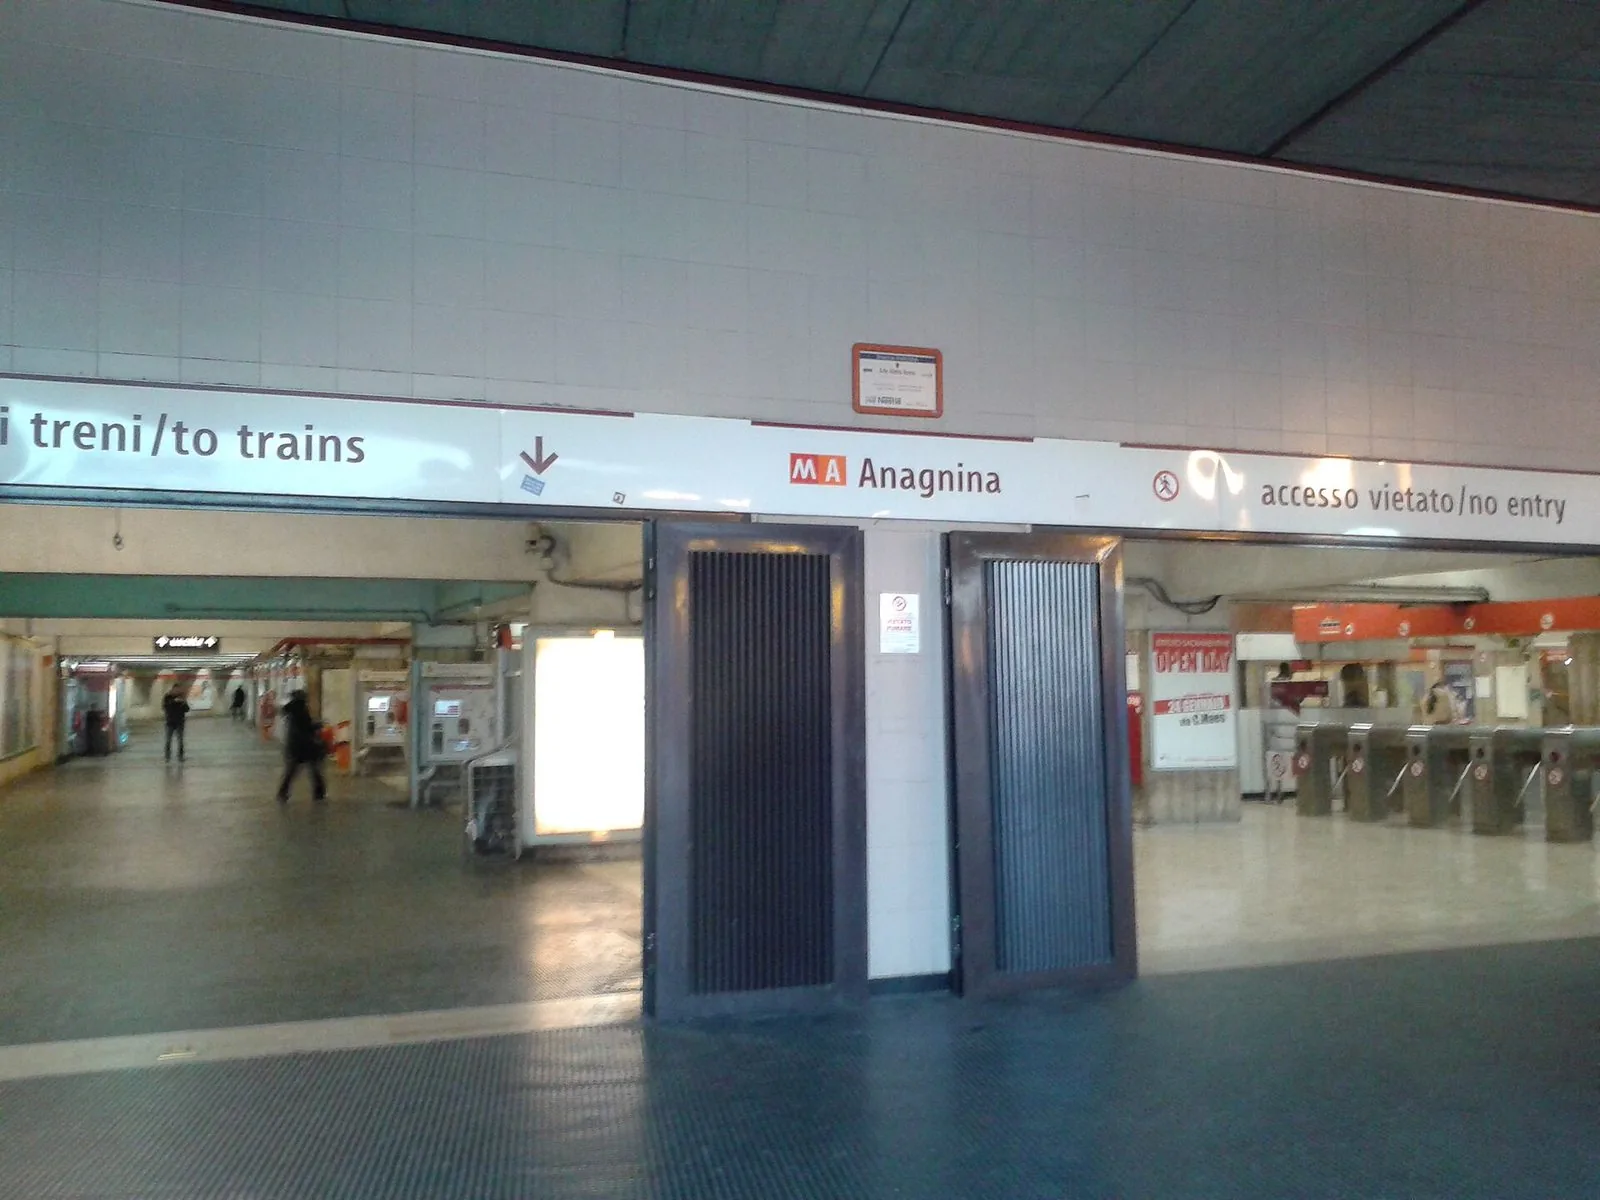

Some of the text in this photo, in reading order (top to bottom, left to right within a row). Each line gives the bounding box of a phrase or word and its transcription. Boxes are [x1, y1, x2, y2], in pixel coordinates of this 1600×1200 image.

[238, 424, 366, 464] trains
[858, 457, 1002, 499] Anagnina
[1260, 483, 1360, 510] accesso
[1506, 494, 1567, 525] entry
[1155, 648, 1233, 674] OPEN DAY
